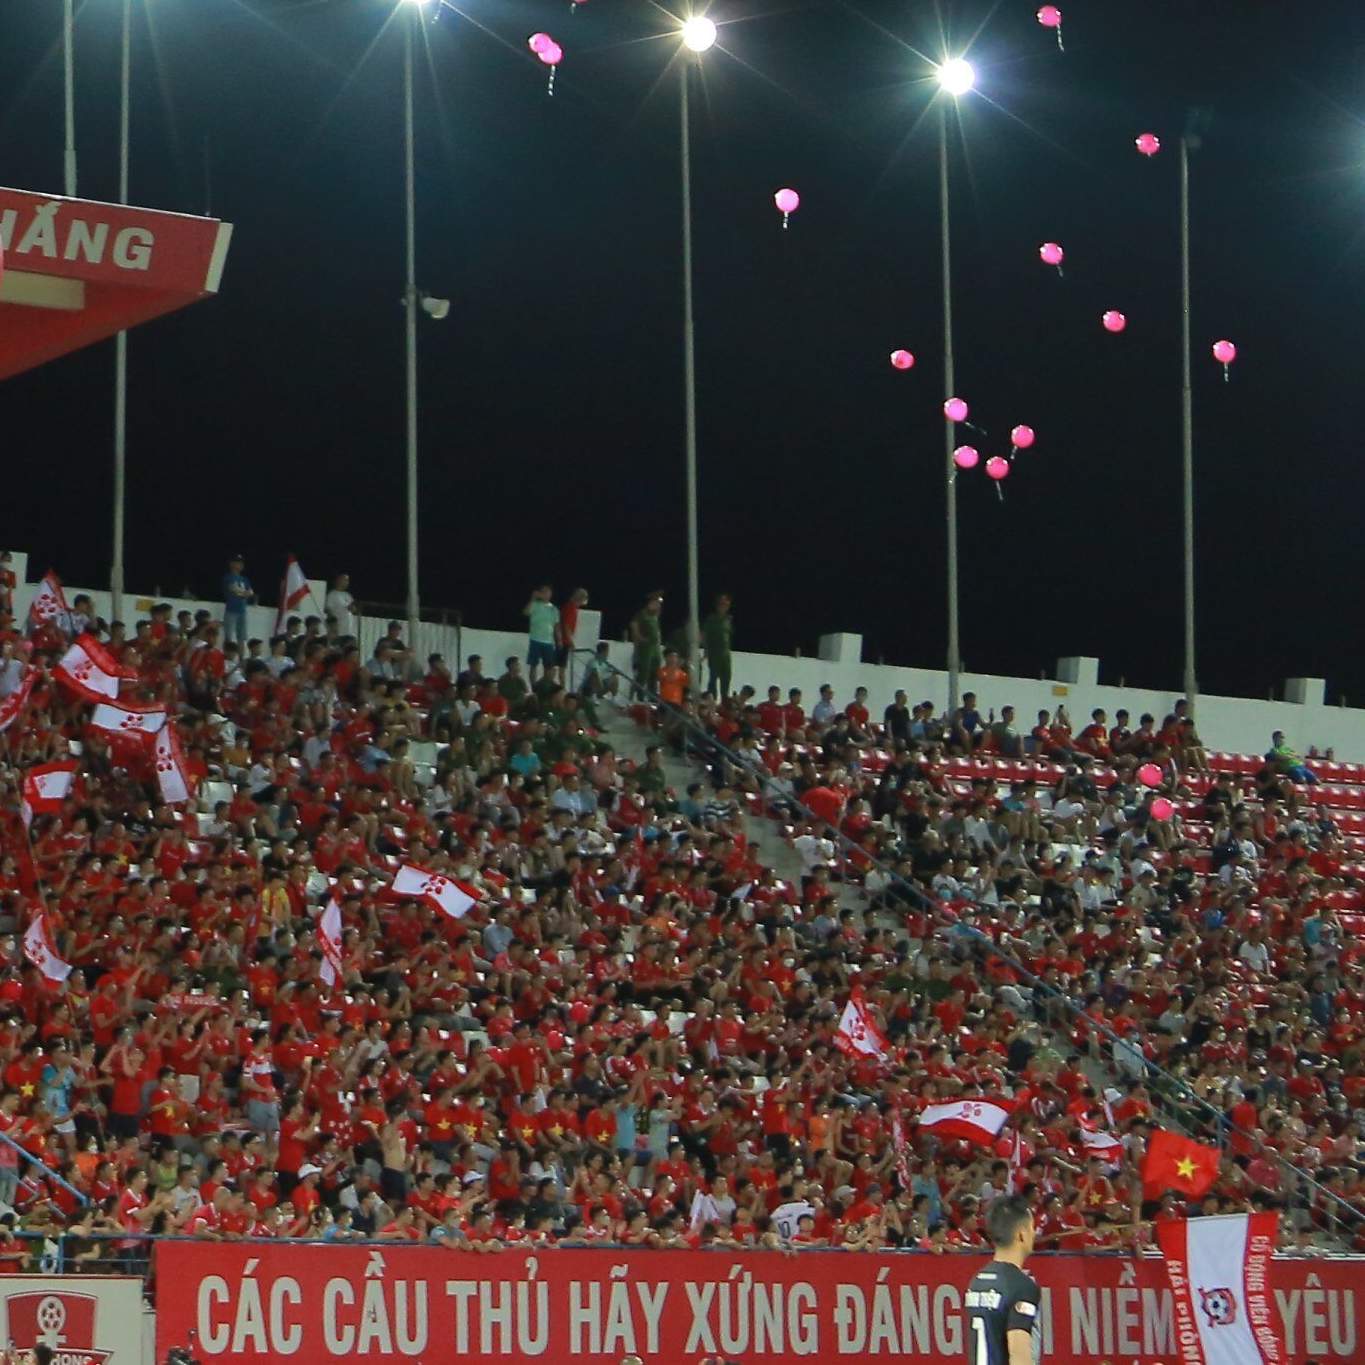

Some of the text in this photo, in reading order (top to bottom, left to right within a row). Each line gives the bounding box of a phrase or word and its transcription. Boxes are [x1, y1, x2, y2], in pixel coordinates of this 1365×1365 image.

[197, 1258, 303, 1356] CÁC
[323, 1251, 428, 1356] CẦU
[446, 1257, 549, 1356] THỦ
[569, 1263, 669, 1355] HÃY
[684, 1264, 818, 1356] XỨNG
[834, 1266, 964, 1356] ĐÁNG
[1070, 1261, 1178, 1355] NIỀM
[1273, 1273, 1356, 1356] YÊU
[1175, 1301, 1205, 1365] PHÒN
